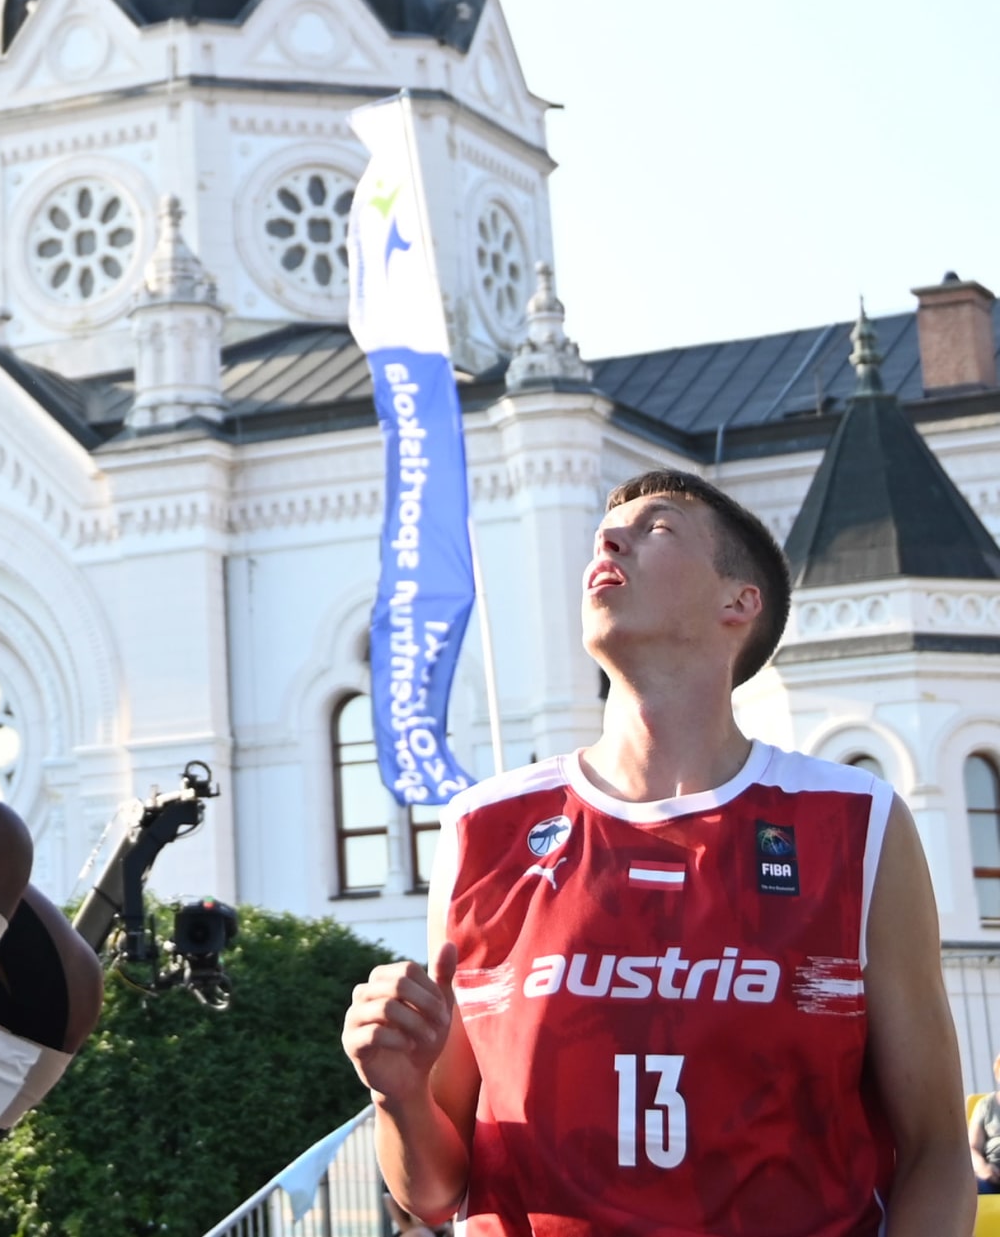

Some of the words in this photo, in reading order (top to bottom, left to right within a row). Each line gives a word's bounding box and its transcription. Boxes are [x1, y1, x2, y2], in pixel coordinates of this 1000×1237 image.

[761, 862, 792, 877] FIBA
[523, 947, 780, 1003] austria
[614, 1053, 687, 1168] 13
